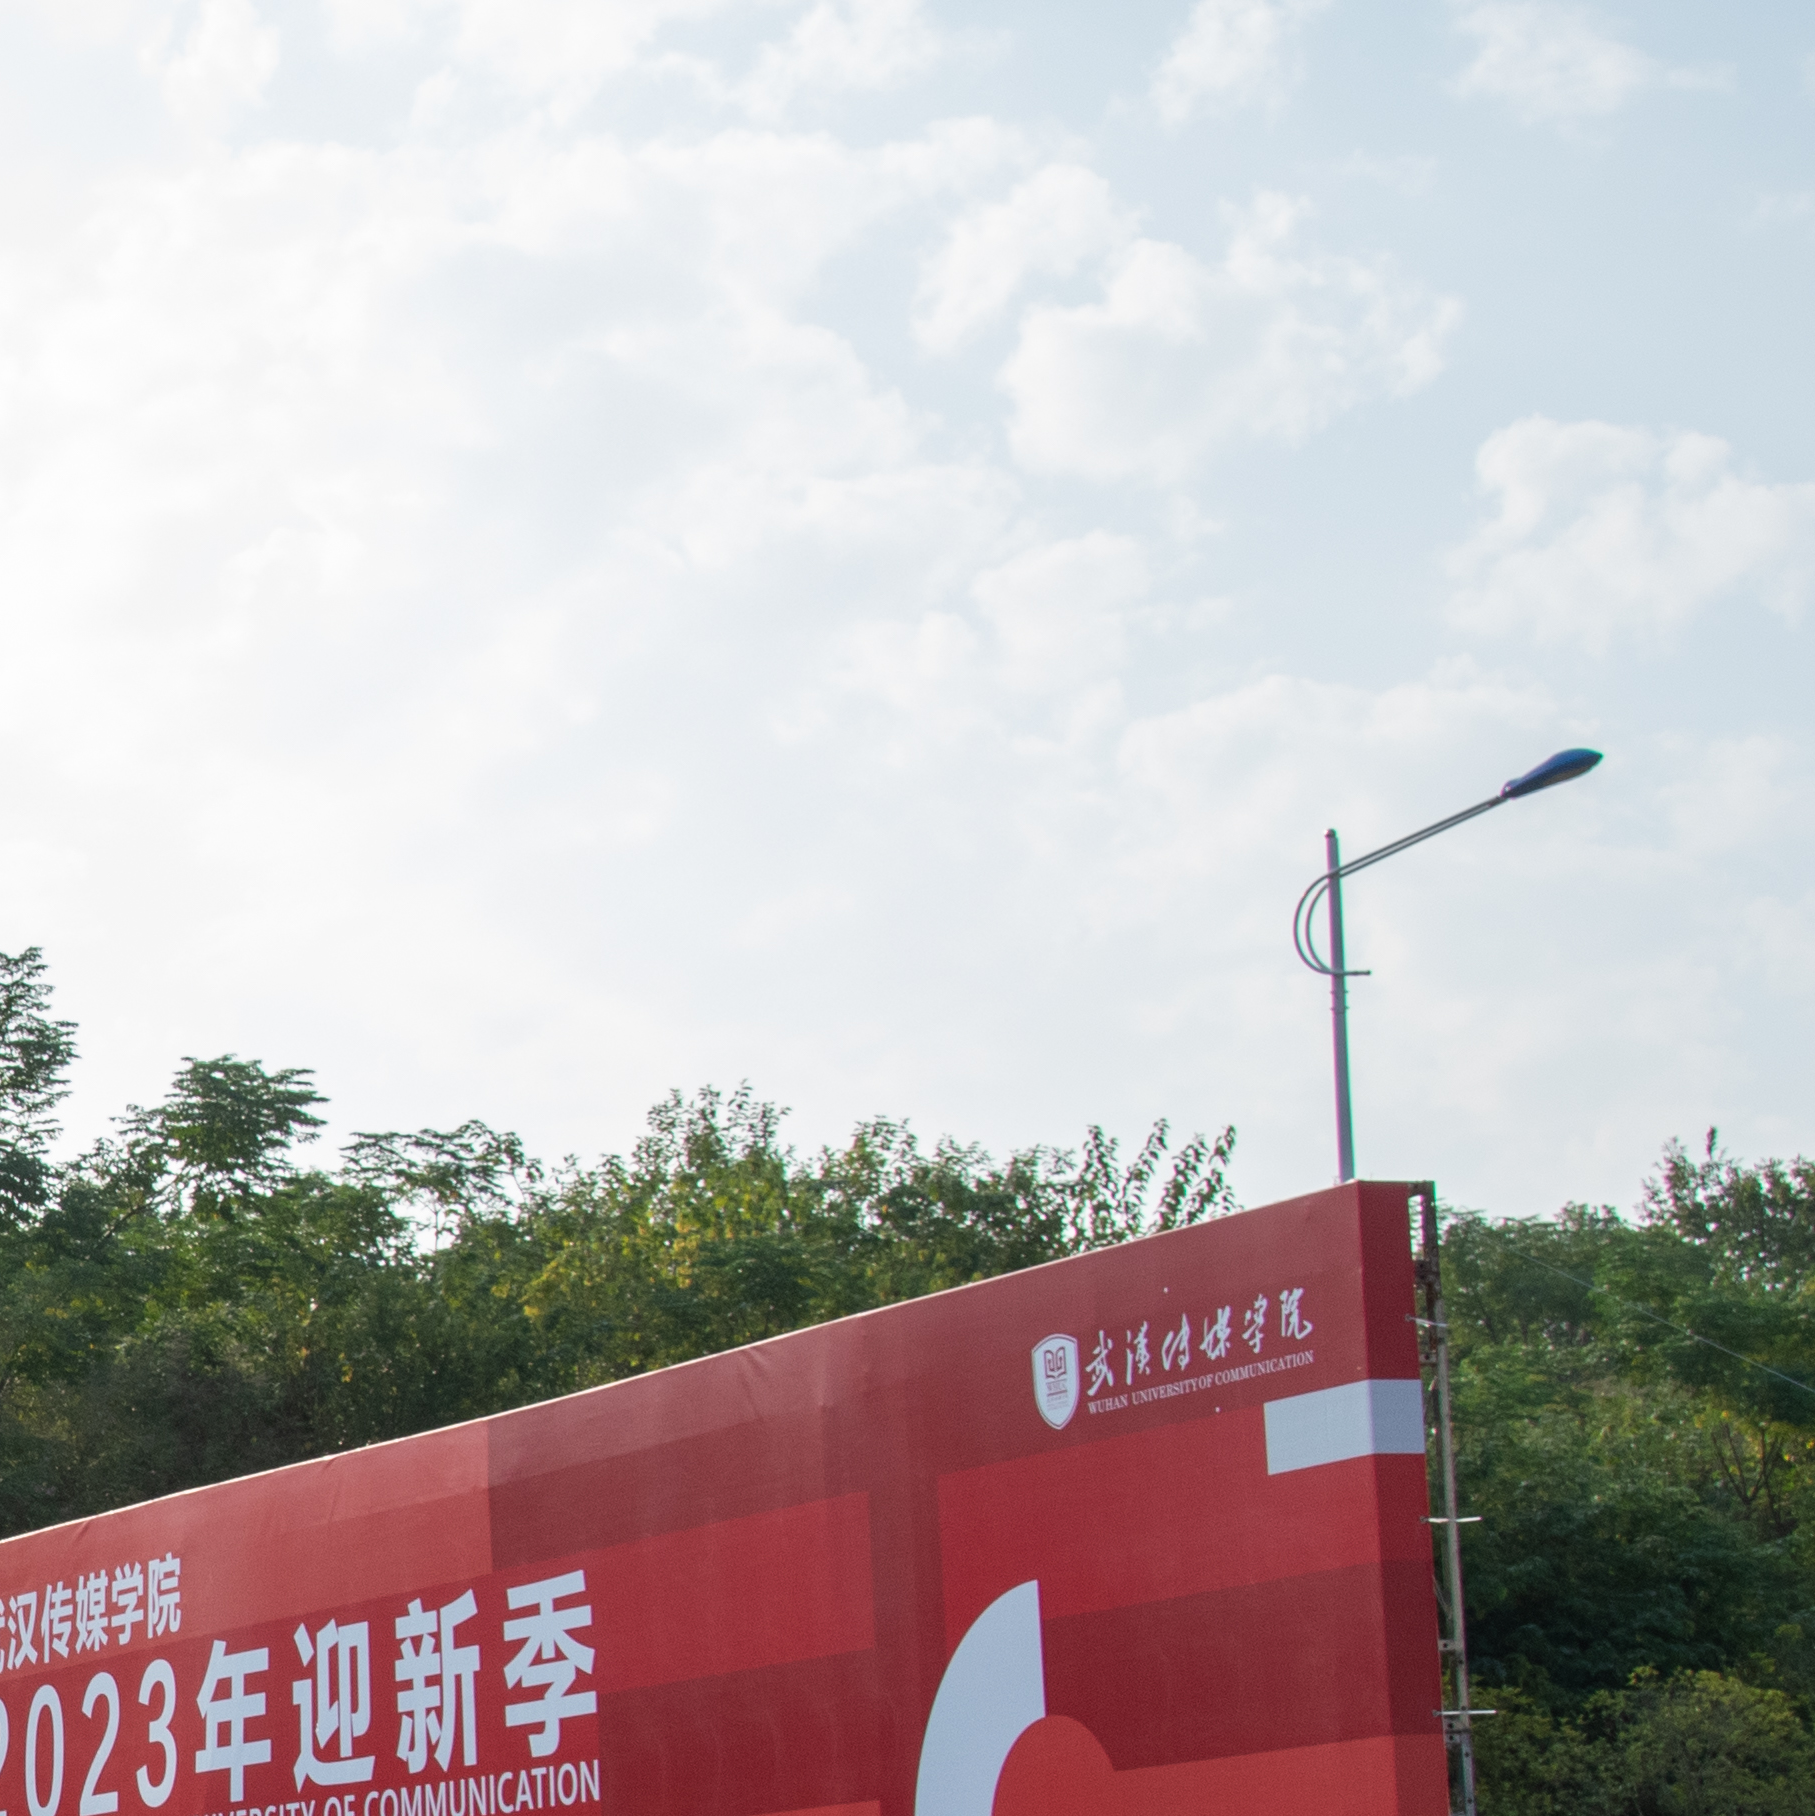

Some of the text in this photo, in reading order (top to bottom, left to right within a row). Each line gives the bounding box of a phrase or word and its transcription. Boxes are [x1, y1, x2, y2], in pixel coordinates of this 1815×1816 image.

[1088, 1394, 1128, 1415] WUHAN
[1131, 1376, 1197, 1406] UNIVERSITY
[1198, 1373, 1215, 1390] OF
[1215, 1349, 1314, 1386] COMMUNICATION
